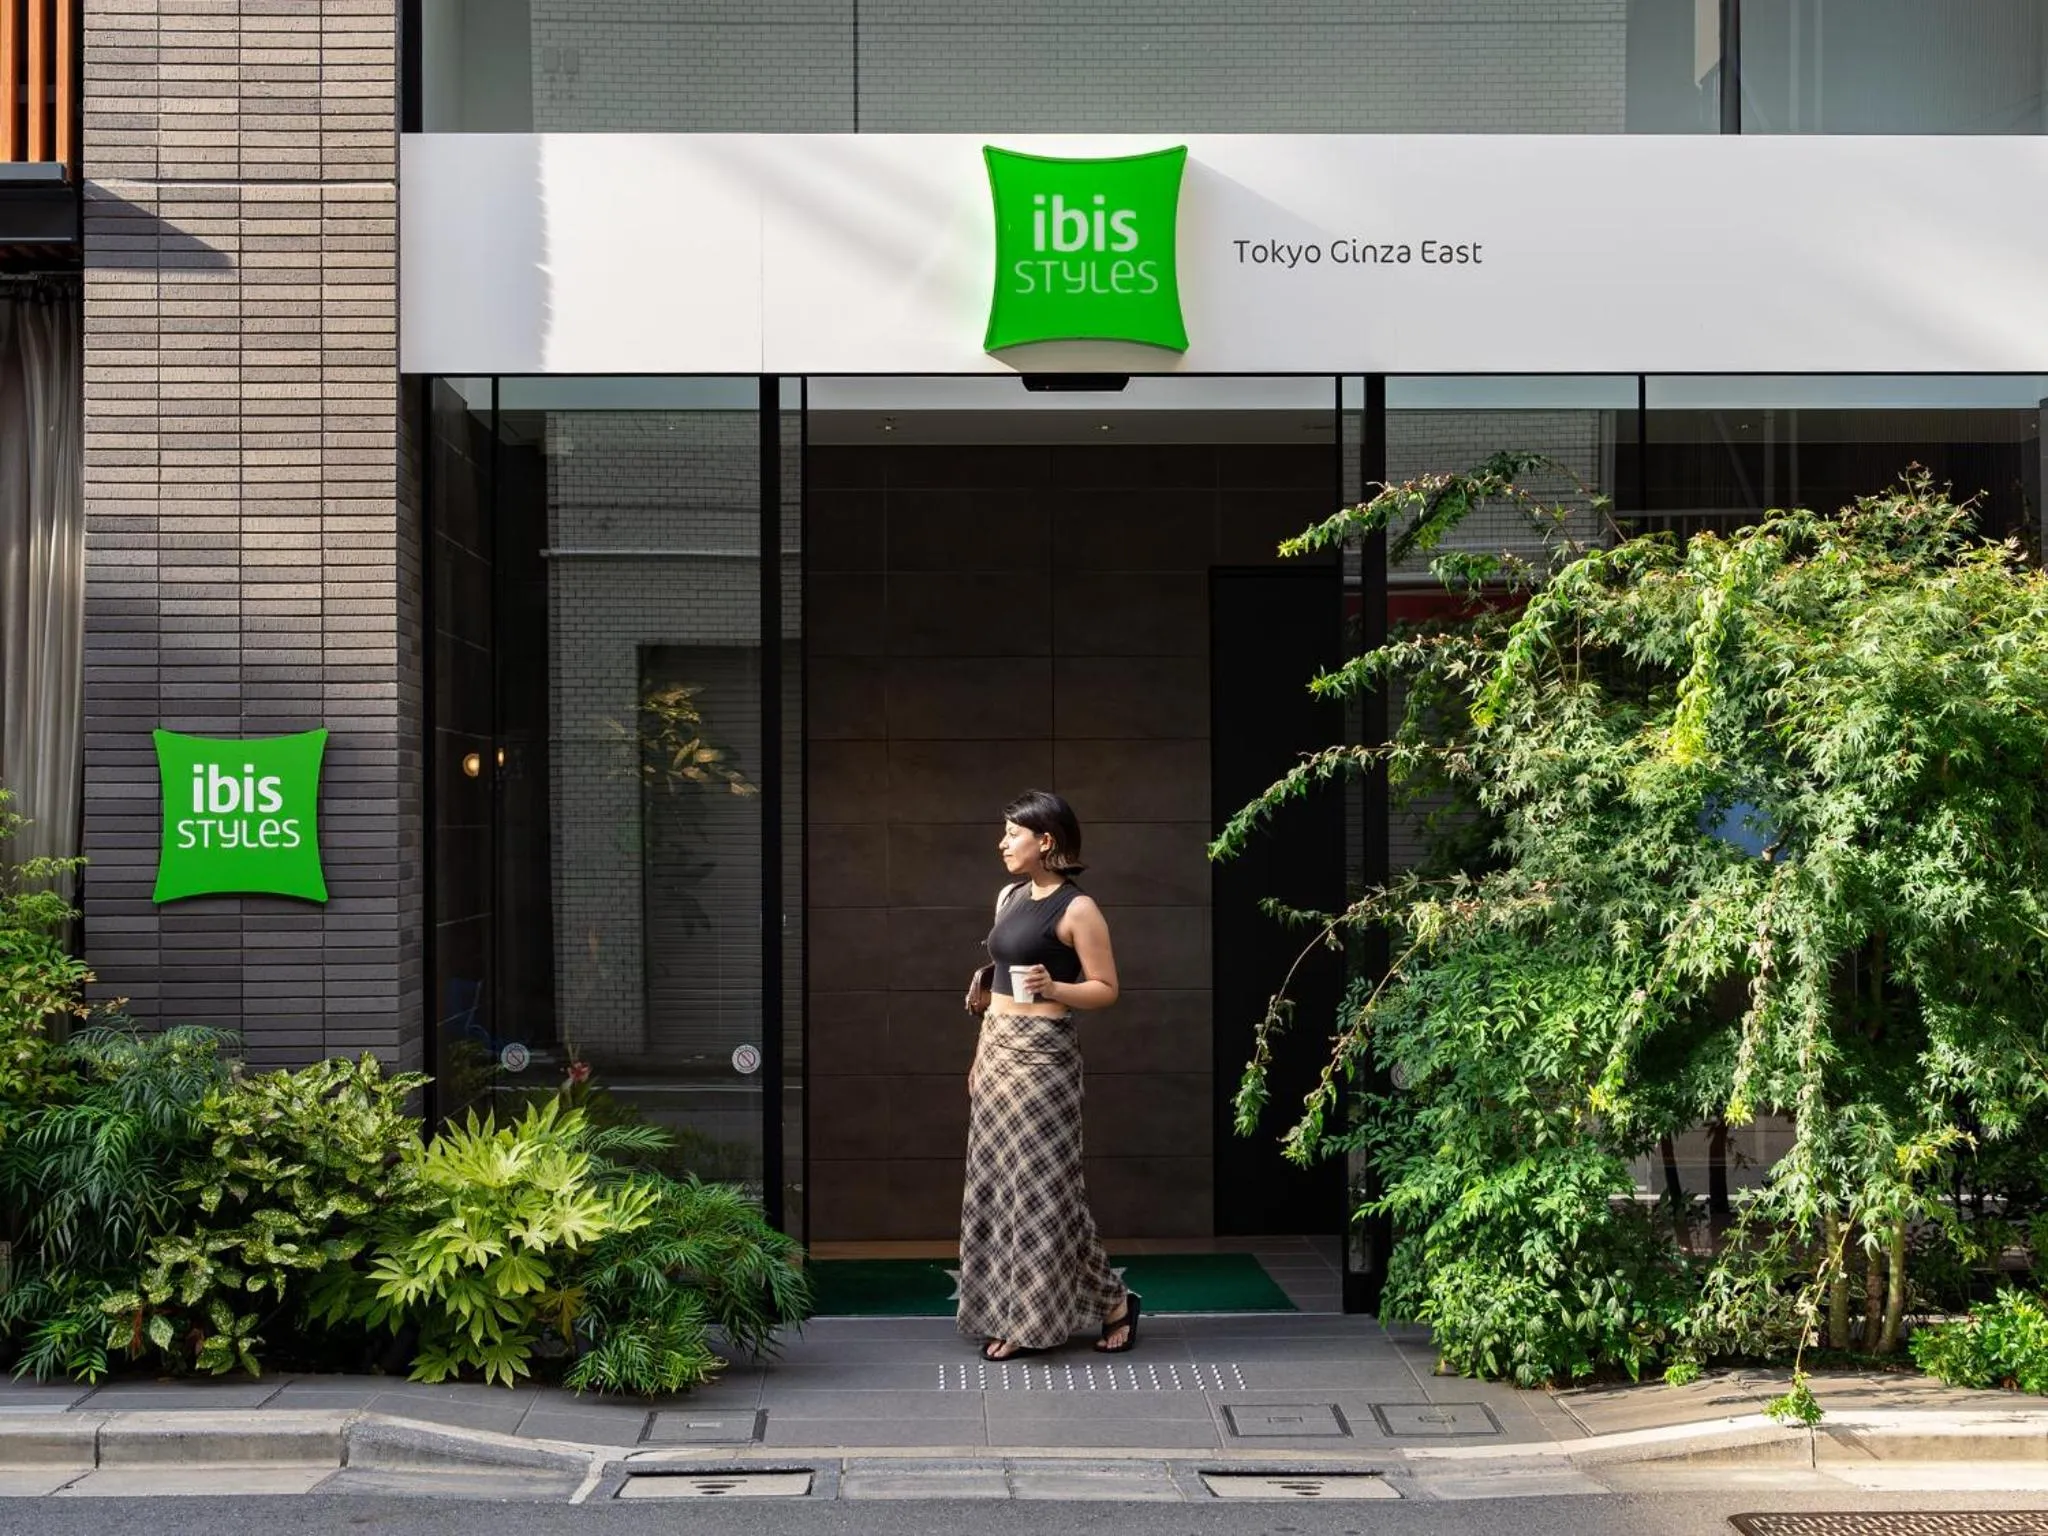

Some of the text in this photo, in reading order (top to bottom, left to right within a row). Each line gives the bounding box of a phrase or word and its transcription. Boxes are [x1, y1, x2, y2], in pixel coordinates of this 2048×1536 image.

[1033, 194, 1139, 252] ibis
[1233, 238, 1483, 269] Tokyo Ginza East
[192, 763, 284, 814] ibis
